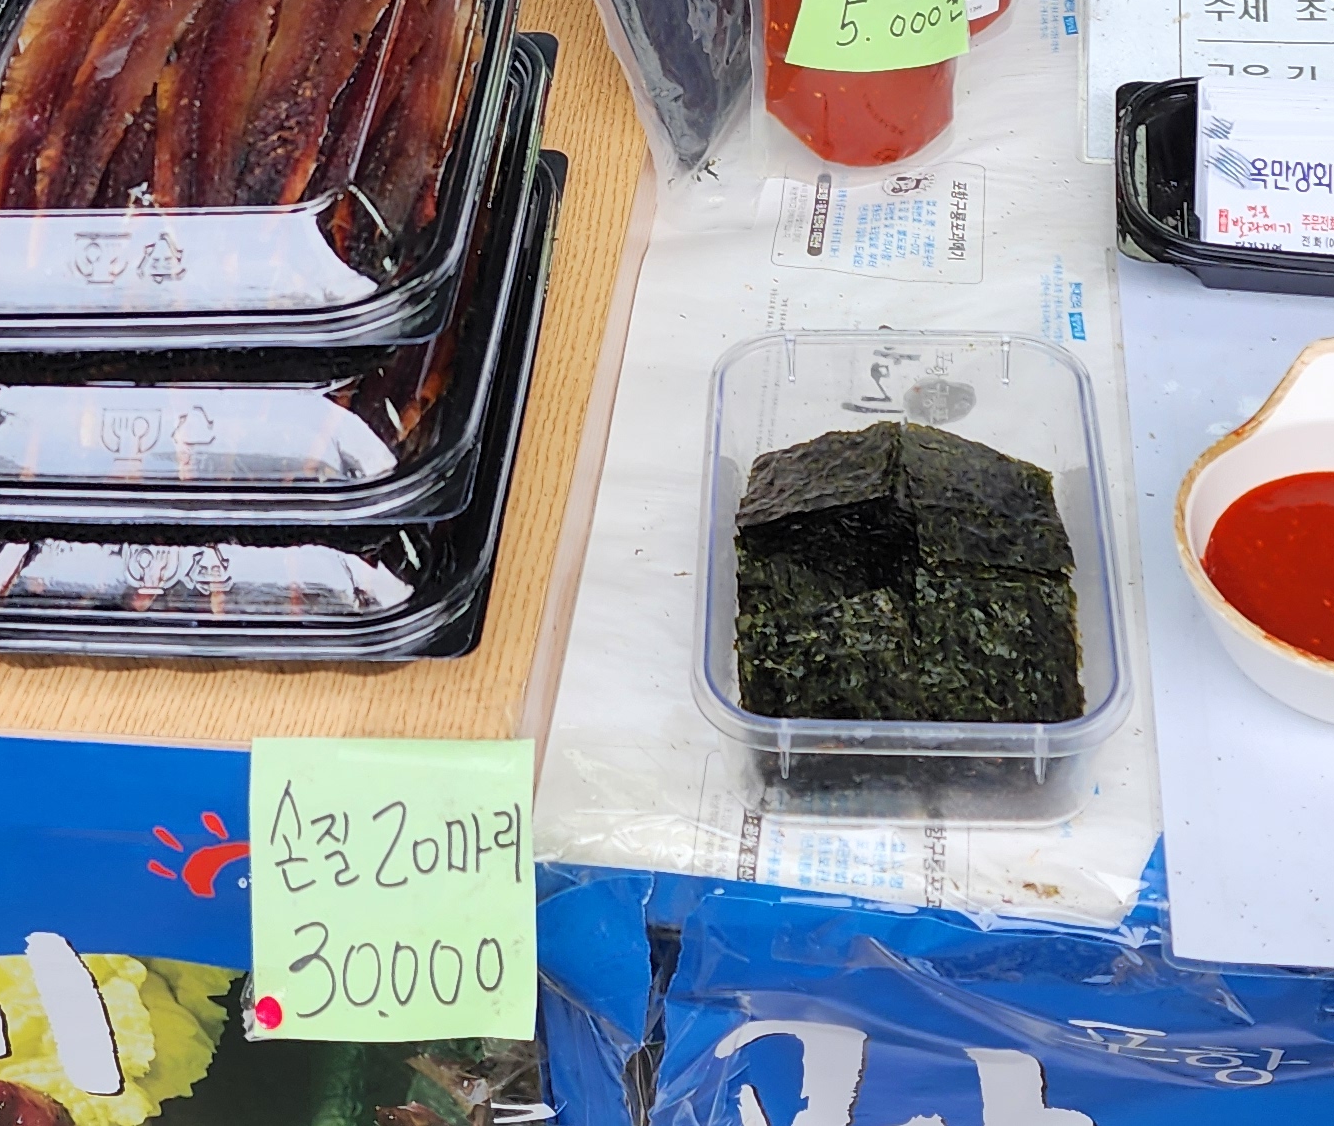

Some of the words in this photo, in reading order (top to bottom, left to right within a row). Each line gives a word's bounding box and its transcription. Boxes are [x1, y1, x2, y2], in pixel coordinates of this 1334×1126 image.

[947, 180, 967, 262] 포항구룡포과메기
[270, 780, 361, 892] 손질
[371, 801, 522, 888] 20마리
